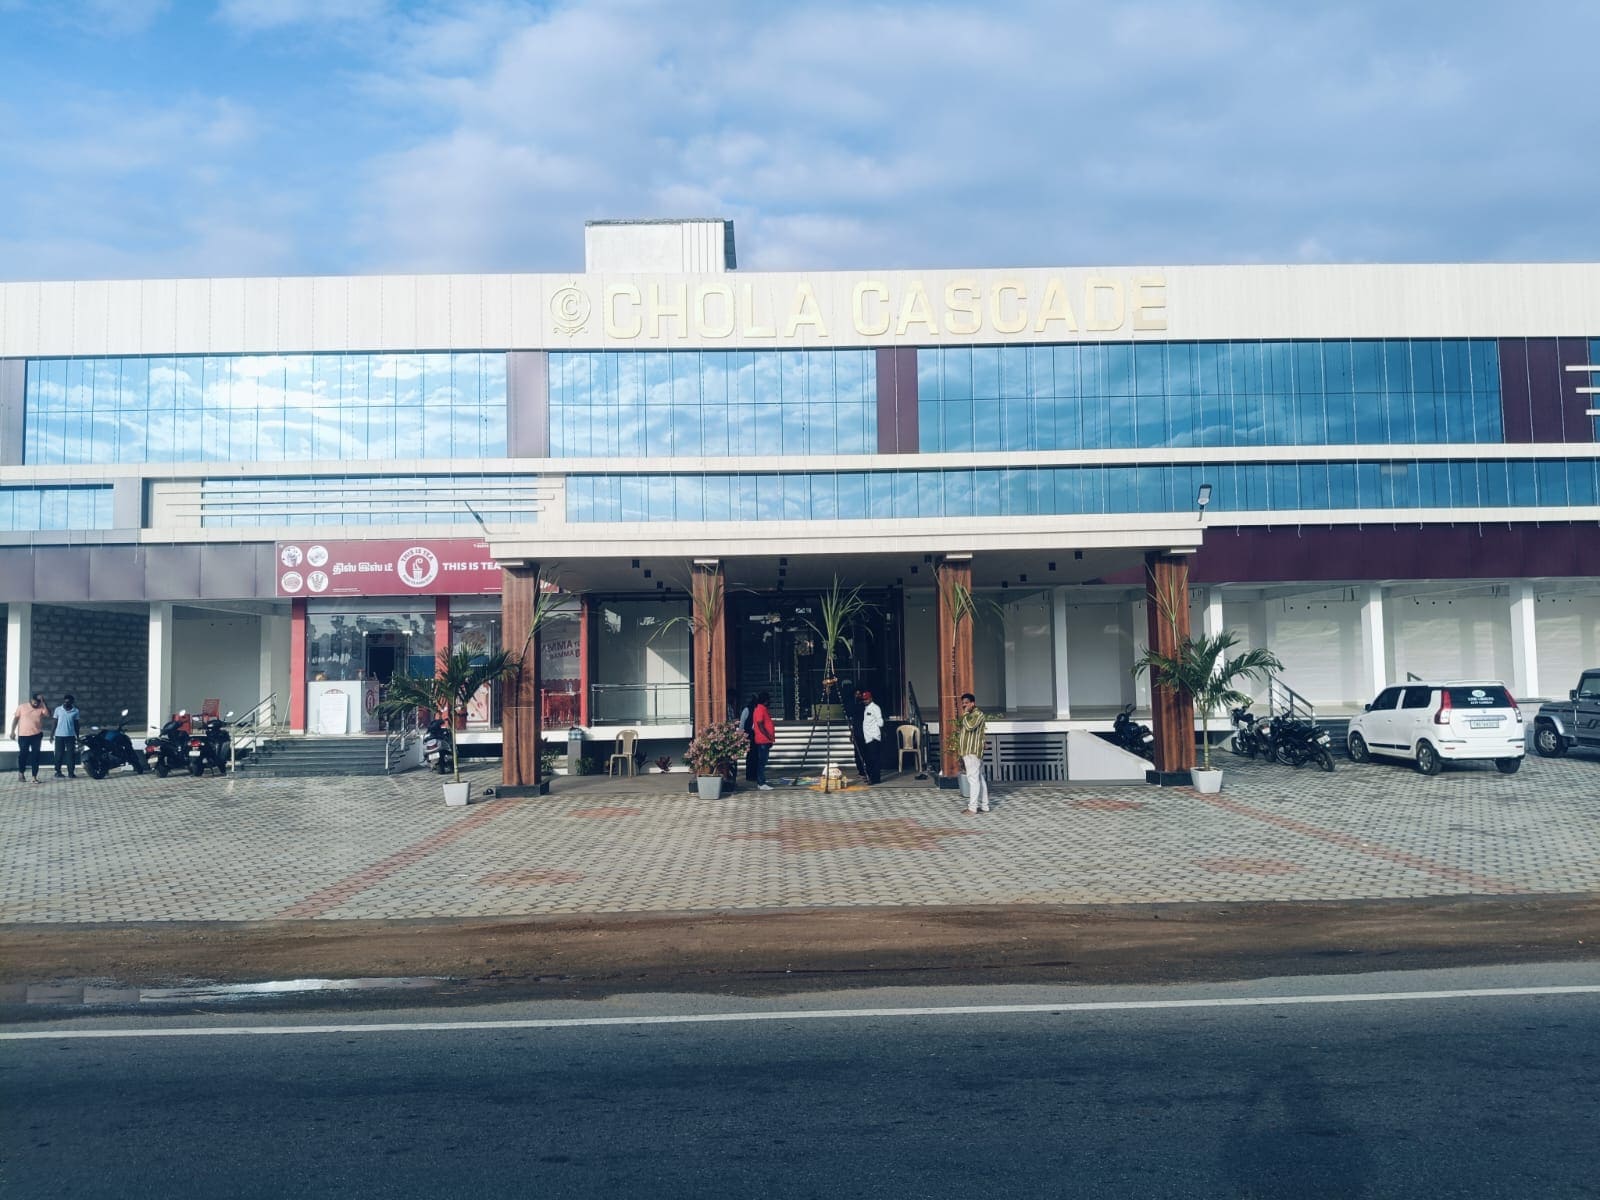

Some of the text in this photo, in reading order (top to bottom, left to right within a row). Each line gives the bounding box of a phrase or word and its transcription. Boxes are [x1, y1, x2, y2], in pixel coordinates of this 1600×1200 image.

[605, 273, 1167, 340] CHOLA CASCADE
[400, 549, 414, 562] THIS
[422, 549, 434, 562] TEA
[442, 561, 502, 571] THIS IS TEA
